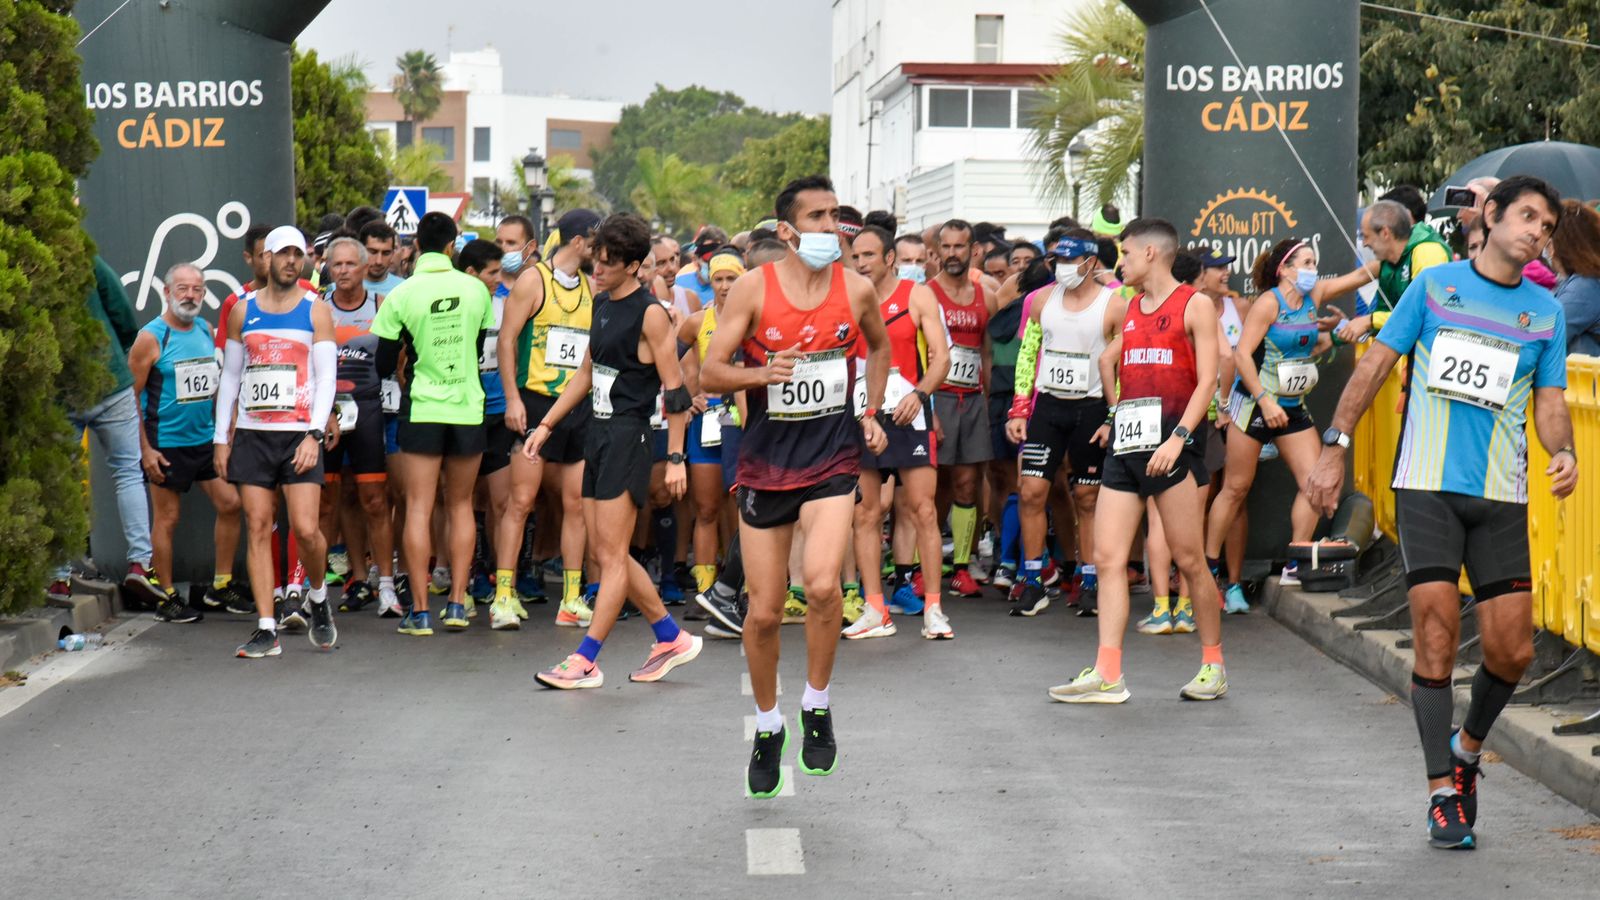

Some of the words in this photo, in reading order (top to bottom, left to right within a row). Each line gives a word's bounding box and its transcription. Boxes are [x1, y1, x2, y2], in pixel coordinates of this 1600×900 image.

[1166, 64, 1214, 92] LOS
[1222, 61, 1344, 92] BARRIOS
[85, 82, 127, 109] LOS
[134, 79, 264, 108] BARRIOS
[1201, 96, 1310, 132] CÁDIZ
[117, 112, 226, 149] CÁDIZ
[1251, 210, 1277, 236] BTT
[559, 343, 576, 361] 54
[953, 361, 976, 379] 112
[1049, 367, 1074, 385] 195
[1439, 355, 1490, 390] 285
[184, 374, 209, 393] 162
[252, 382, 280, 402] 304
[782, 379, 825, 406] 500
[1285, 374, 1308, 392] 172
[1119, 420, 1143, 443] 244
